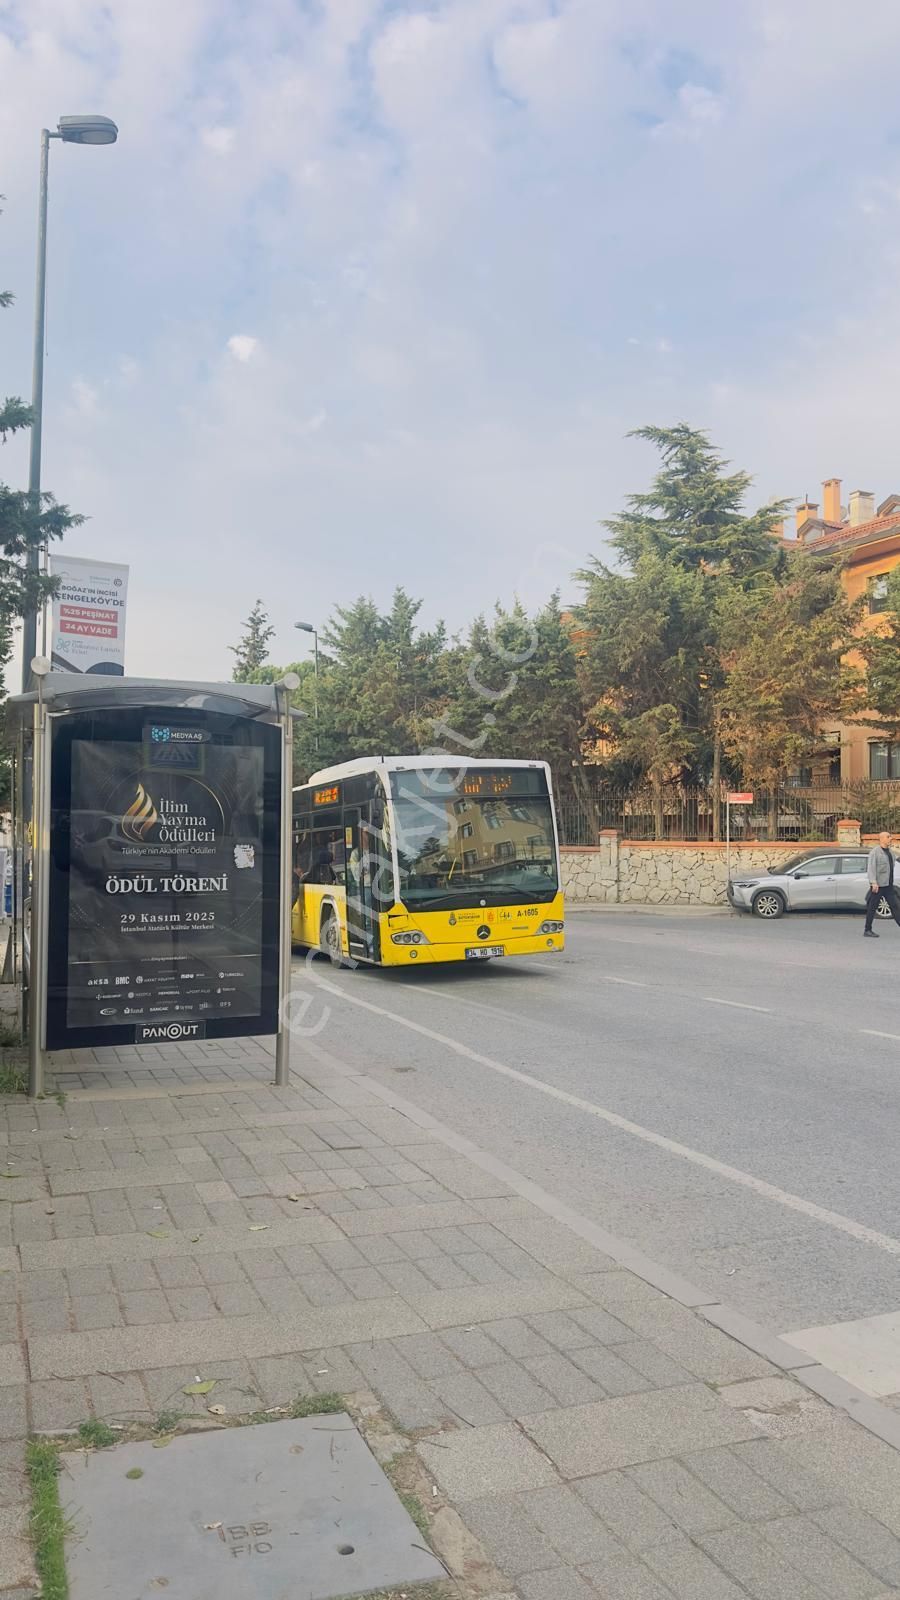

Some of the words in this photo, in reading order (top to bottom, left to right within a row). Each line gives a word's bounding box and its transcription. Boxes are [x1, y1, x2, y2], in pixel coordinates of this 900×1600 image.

[76, 624, 89, 632] AY
[90, 626, 112, 635] VADE
[159, 798, 188, 813] İlim
[159, 814, 206, 829] Yayma
[159, 827, 215, 842] Ödülleri
[159, 846, 188, 854] Akademi
[105, 875, 158, 894] ÖDÜL
[160, 873, 228, 893] TÖRENİ
[120, 914, 136, 923] 29
[140, 913, 180, 923] Kasım
[185, 912, 215, 921] 2025
[517, 908, 538, 917] A-1605
[115, 976, 130, 985] BMC
